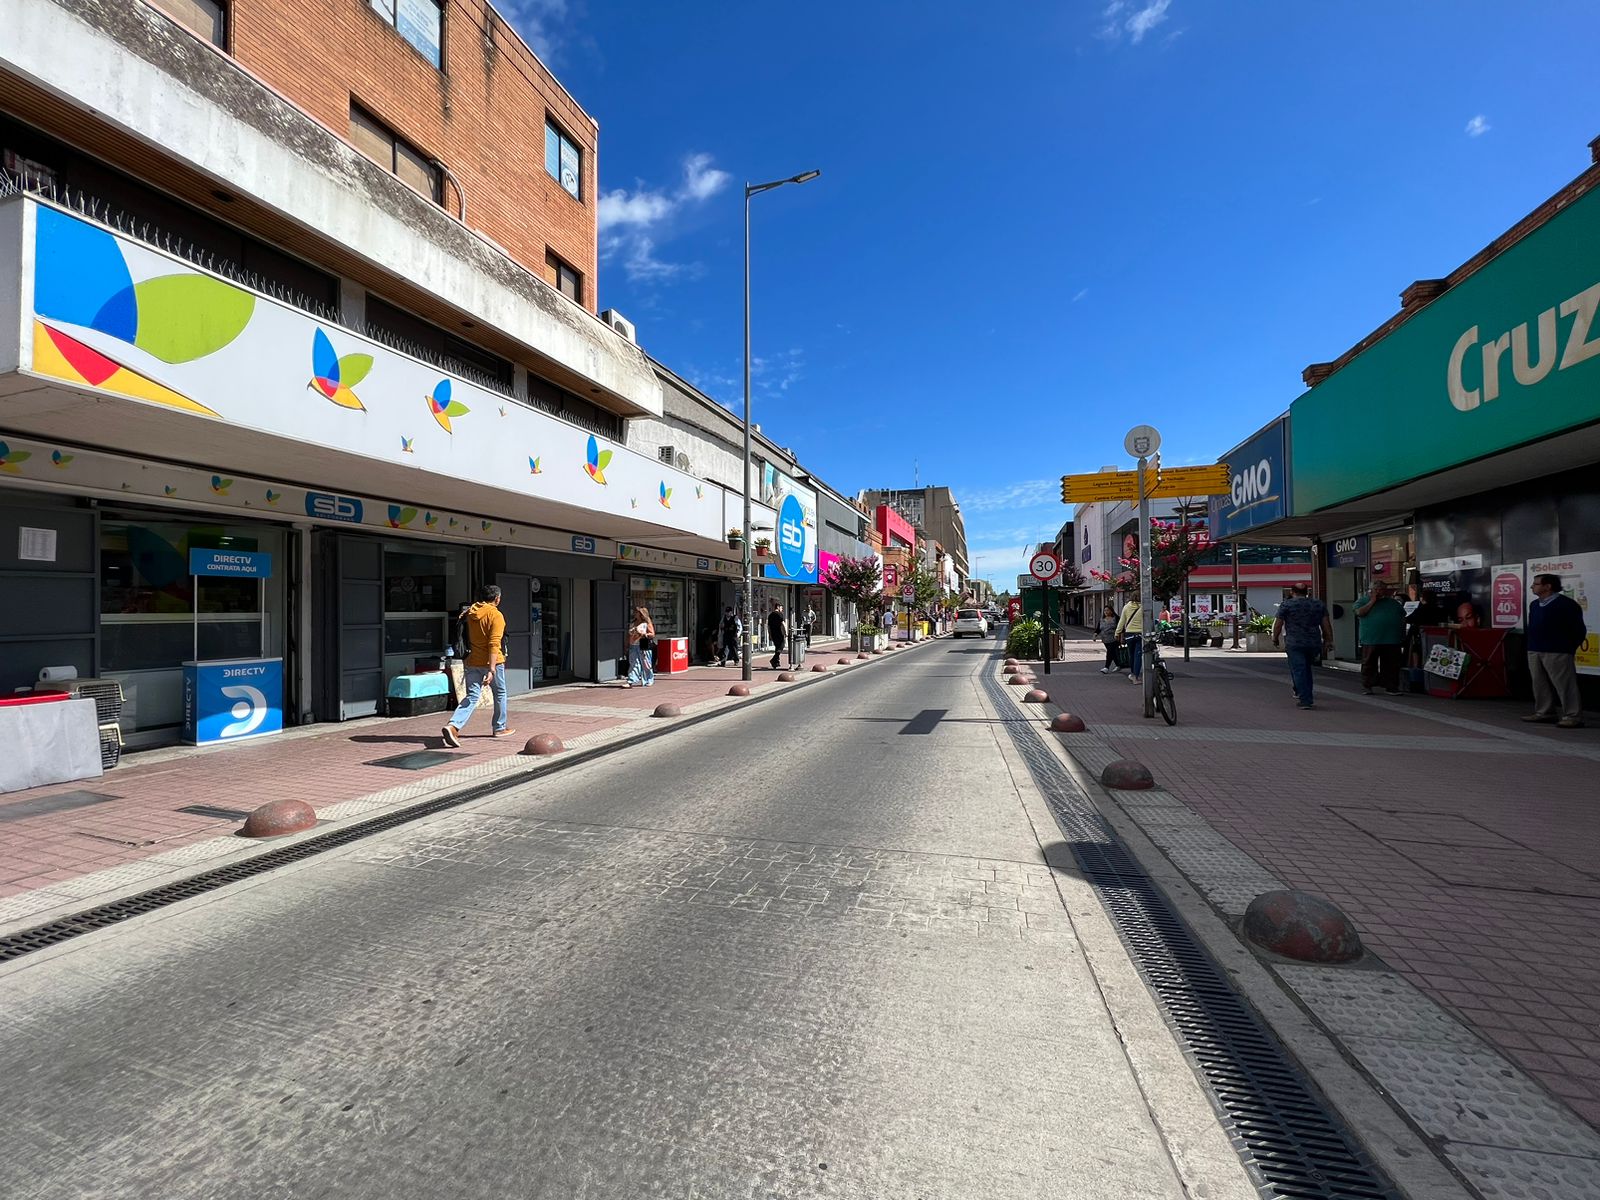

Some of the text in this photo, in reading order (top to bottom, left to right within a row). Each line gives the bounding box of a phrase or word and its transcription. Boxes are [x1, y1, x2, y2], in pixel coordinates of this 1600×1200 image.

[1447, 282, 1600, 411] Cruz
[1231, 459, 1271, 507] GMO
[313, 496, 355, 517] sb
[782, 518, 802, 548] sb
[575, 537, 592, 551] sb
[1335, 537, 1357, 553] GMO
[213, 554, 252, 565] DIRECTV
[1035, 560, 1054, 572] 30
[207, 563, 241, 572] CONTRATA
[1422, 580, 1451, 588] ANTHELIOS
[223, 667, 266, 678] DIRECTV
